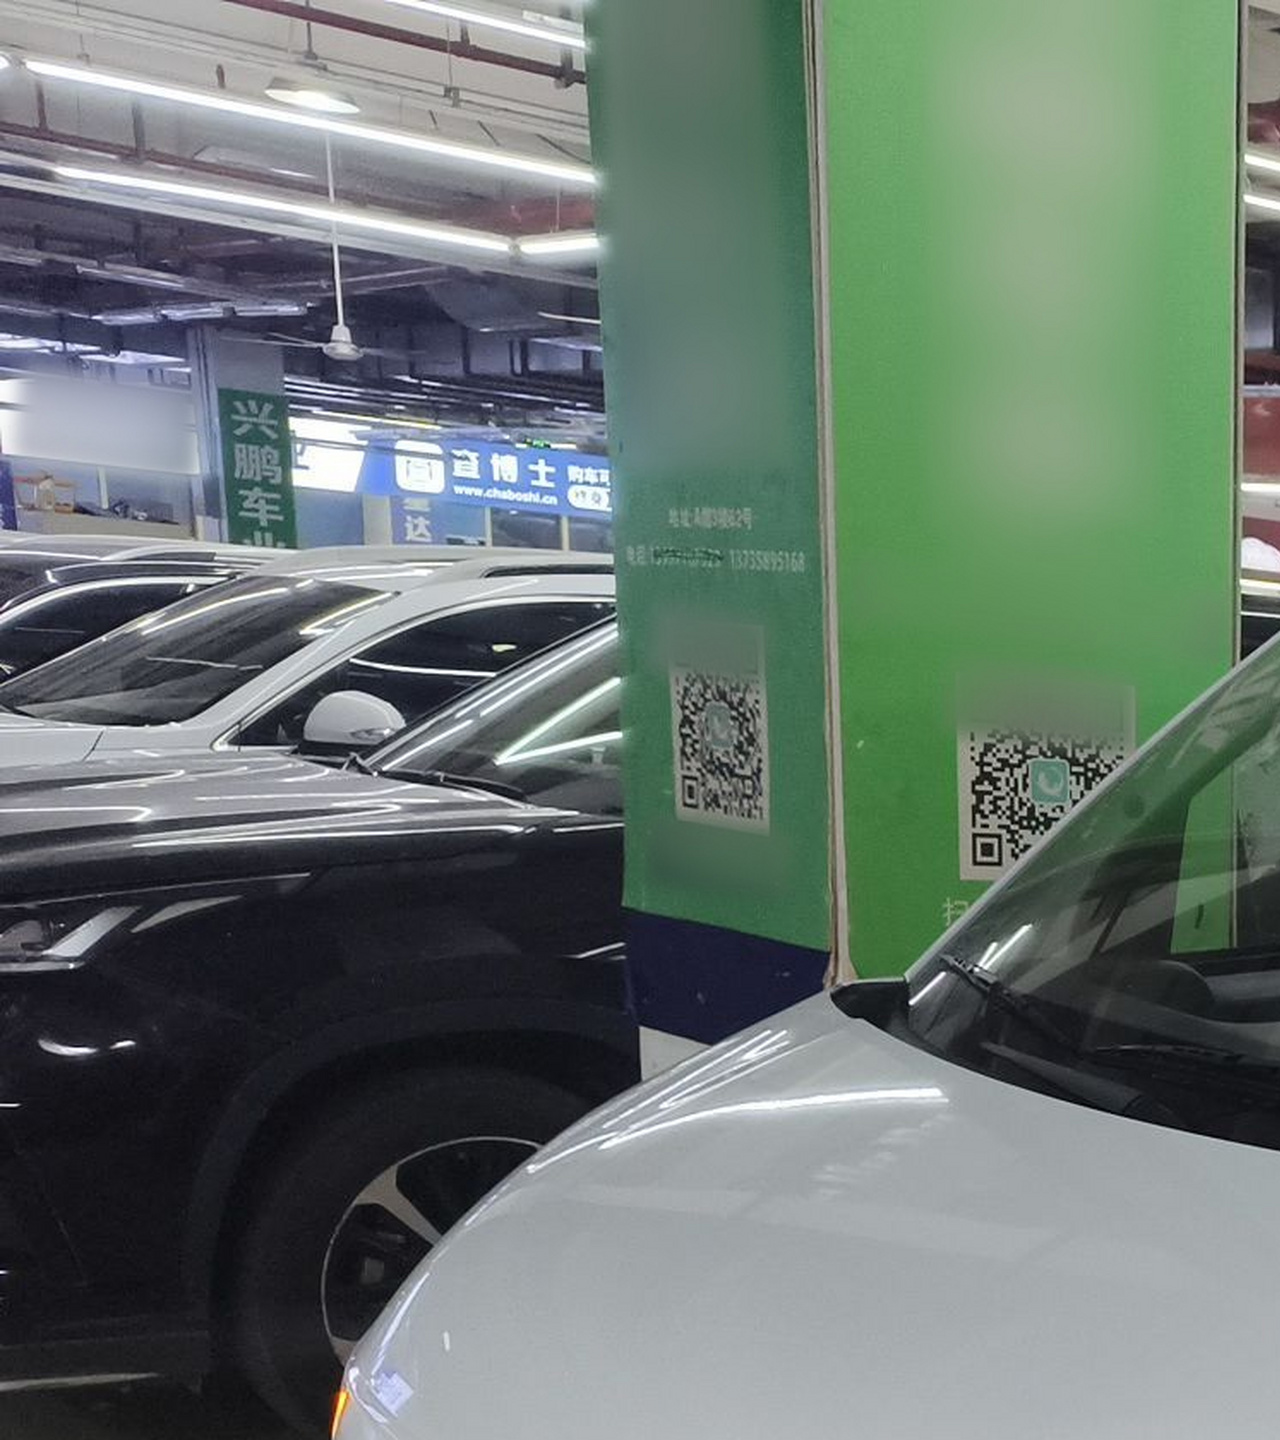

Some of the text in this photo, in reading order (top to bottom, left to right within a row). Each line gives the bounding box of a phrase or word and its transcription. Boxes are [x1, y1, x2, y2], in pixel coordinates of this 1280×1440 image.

[452, 448, 556, 488] 查博士
[453, 484, 558, 505] www.chaboshi.cn
